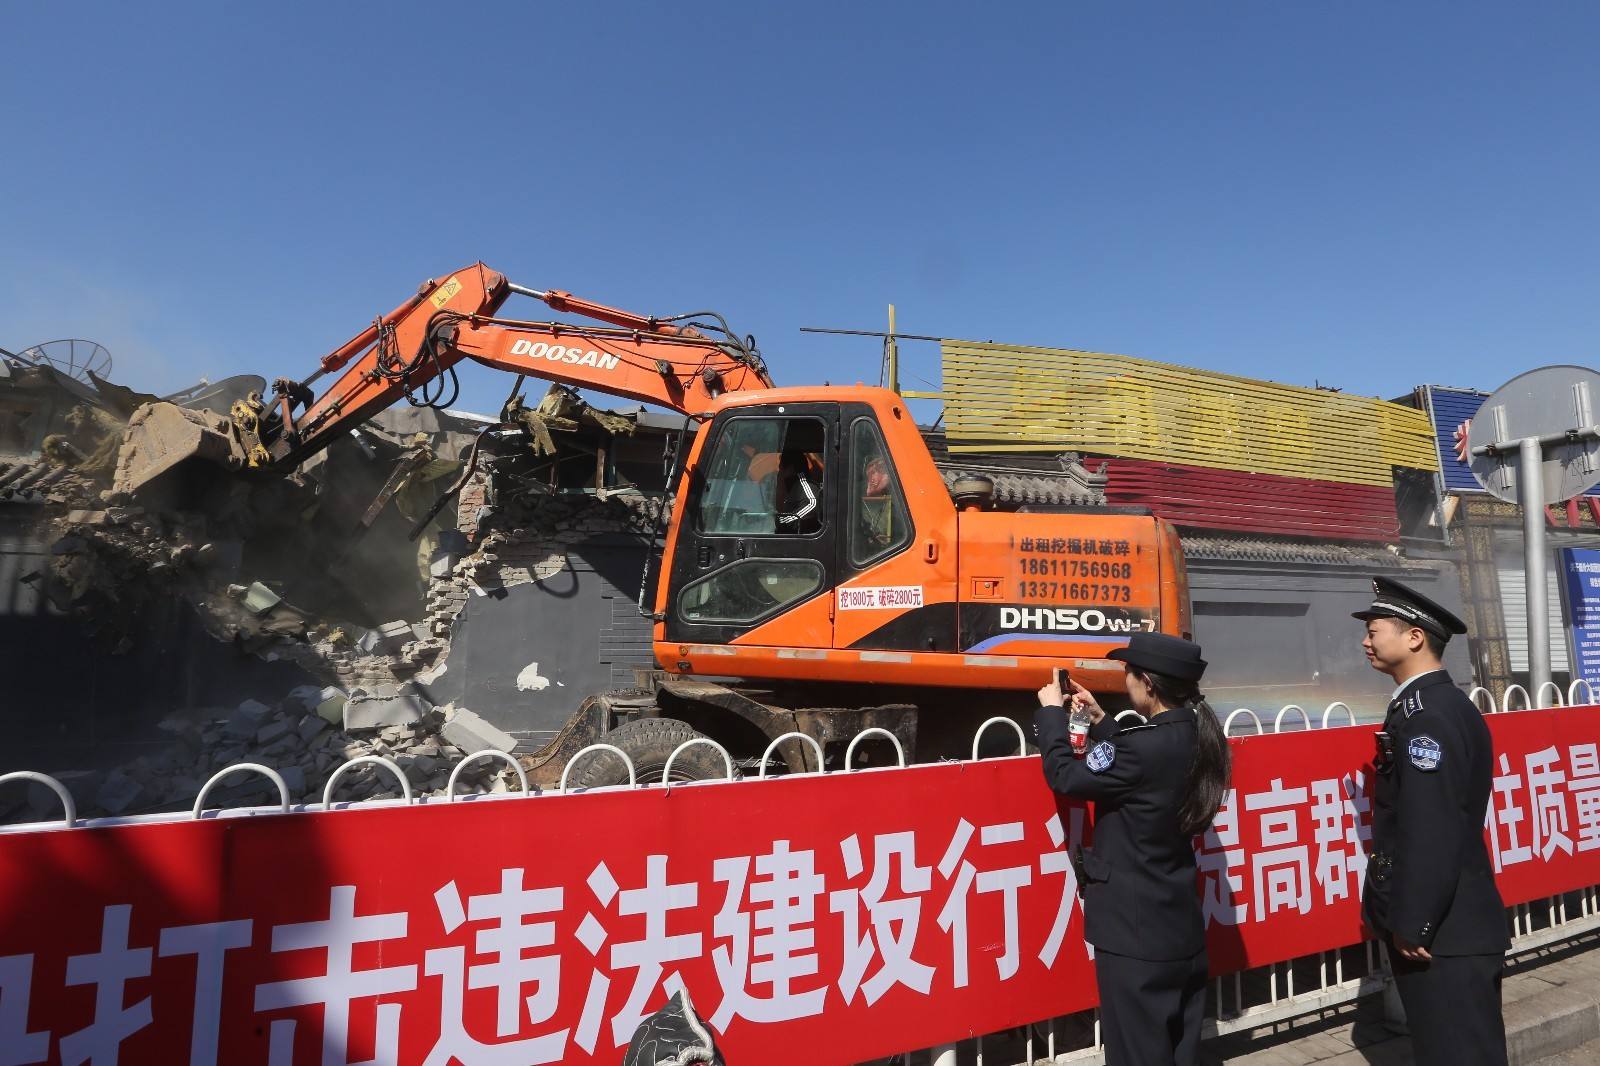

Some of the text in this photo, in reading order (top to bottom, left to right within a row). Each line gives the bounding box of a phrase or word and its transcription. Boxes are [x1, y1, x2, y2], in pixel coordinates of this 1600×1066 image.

[510, 339, 622, 370] DOOSAN
[1020, 536, 1131, 557] 出租挖掘机破碎
[1019, 558, 1132, 580] 18611756968
[840, 588, 921, 608] 挖1800元 破碎2800元
[1018, 581, 1131, 603] 13371667373
